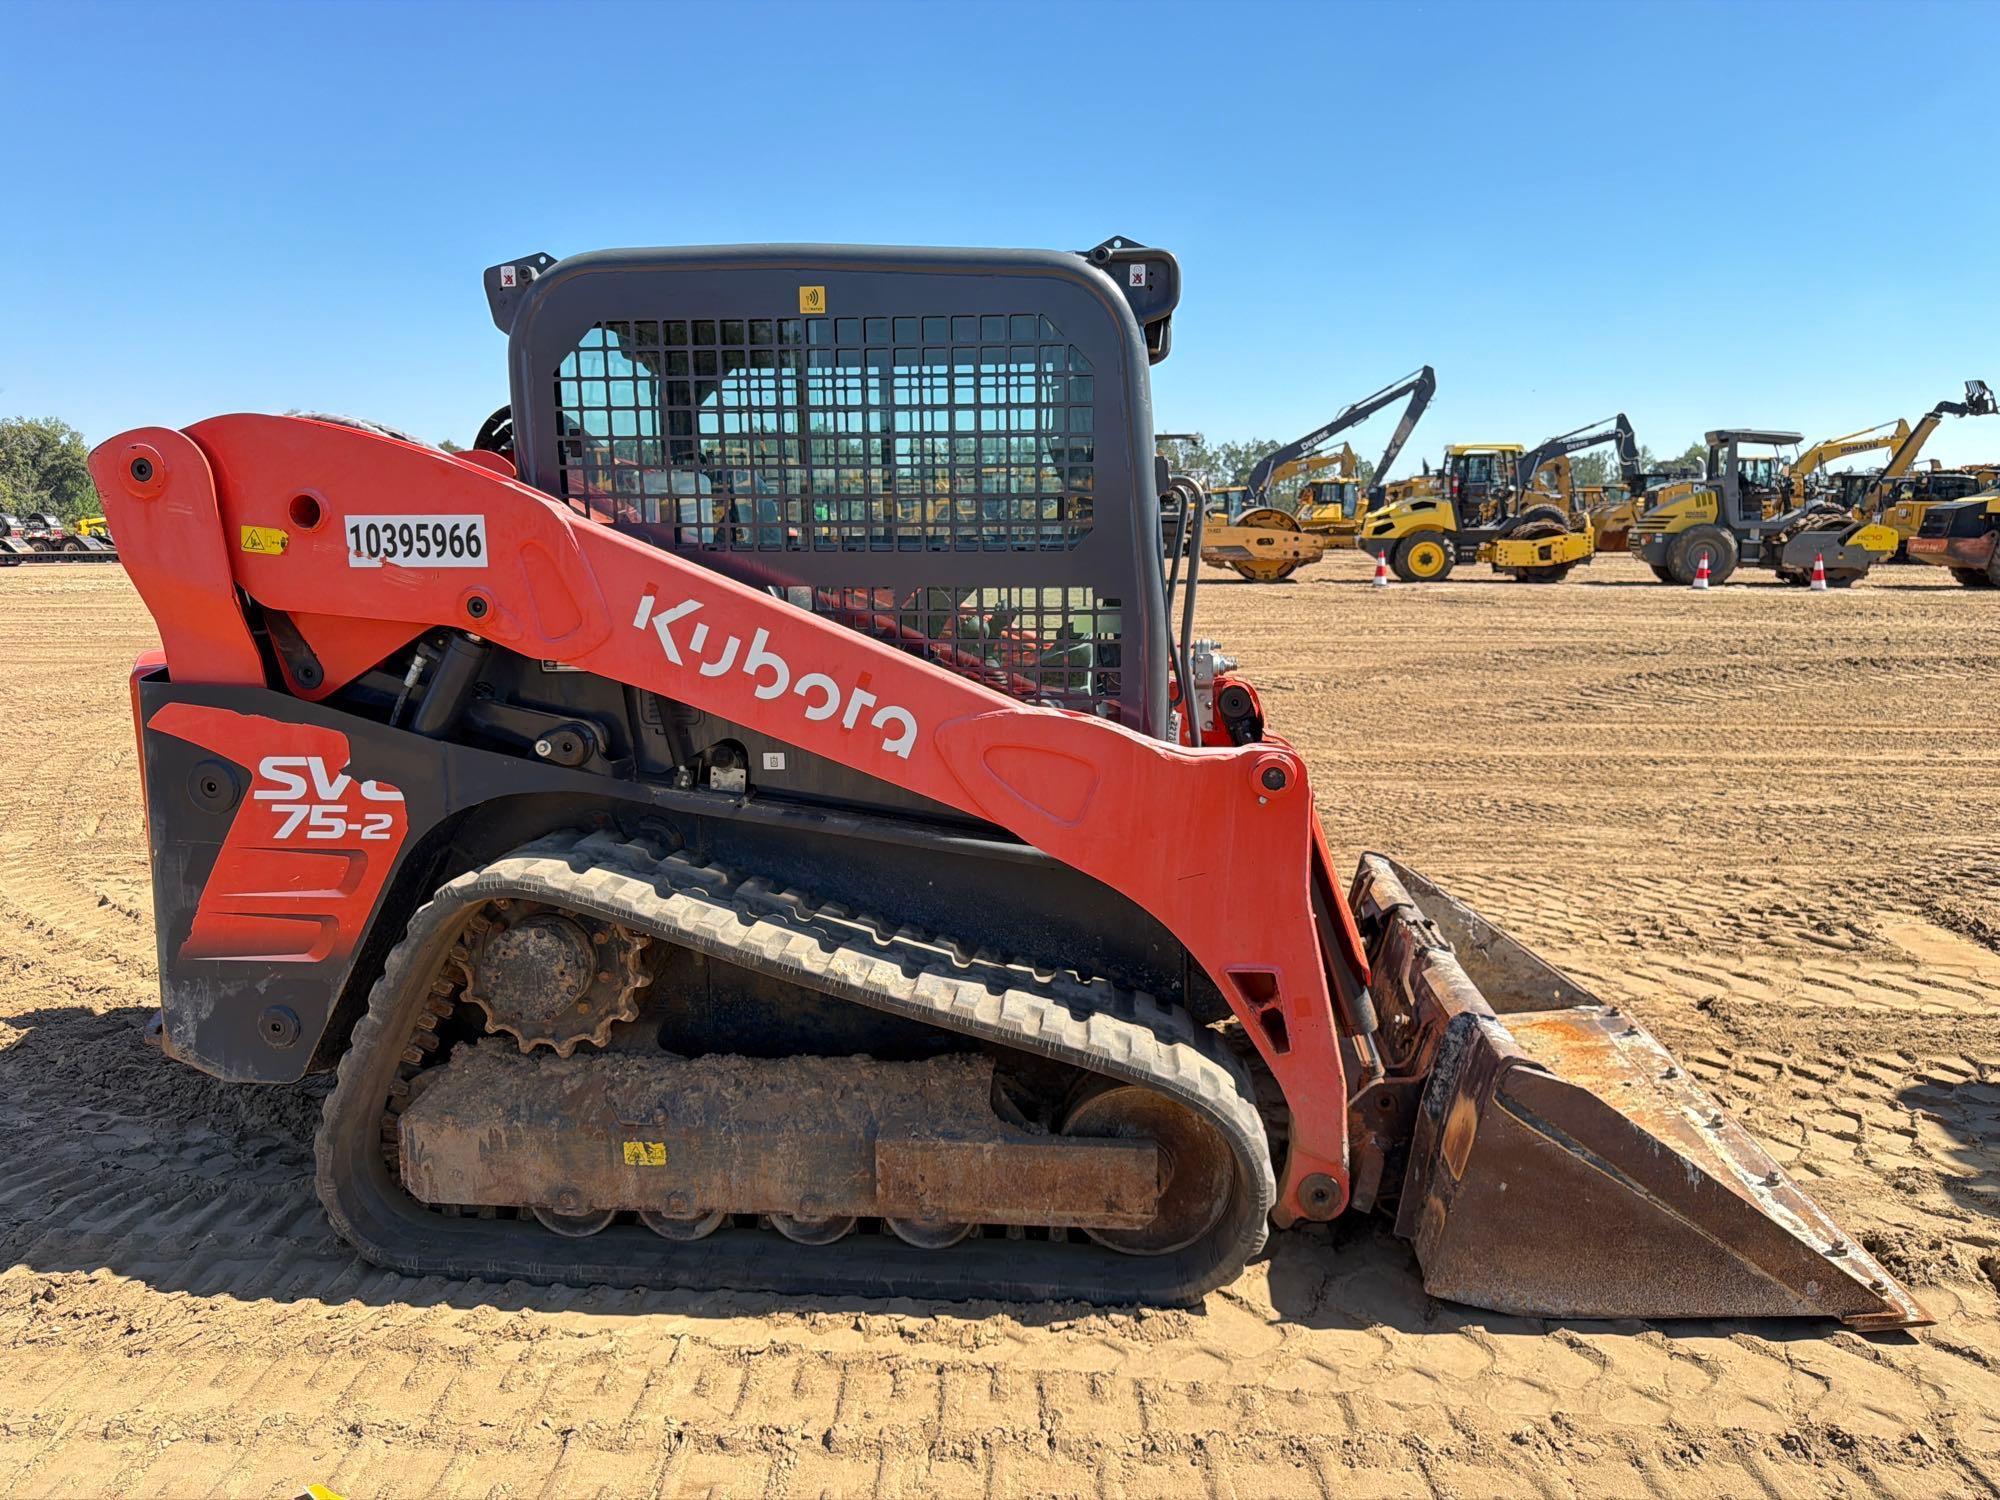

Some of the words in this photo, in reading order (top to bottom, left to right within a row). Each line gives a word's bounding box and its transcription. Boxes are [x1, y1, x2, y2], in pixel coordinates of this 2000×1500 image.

[1300, 430, 1330, 451] DEERE
[1840, 441, 1879, 454] KOMATSU
[349, 523, 482, 558] 10395966
[632, 582, 918, 760] Kubota
[271, 804, 393, 840] 75-2
